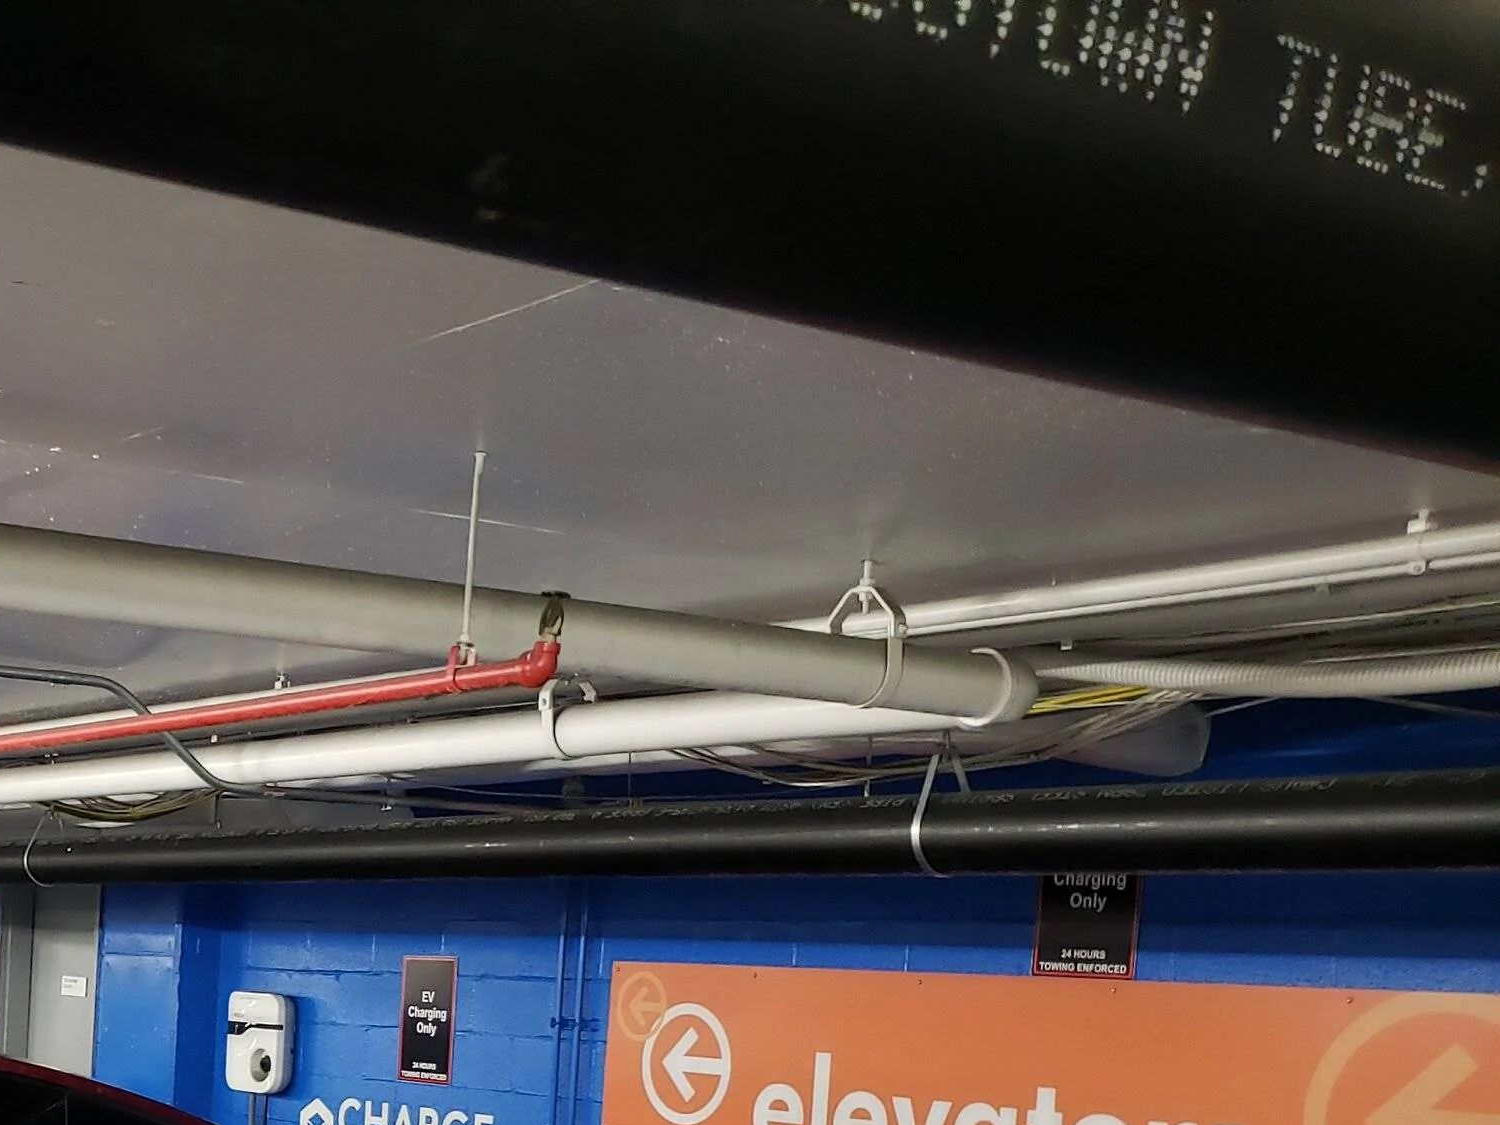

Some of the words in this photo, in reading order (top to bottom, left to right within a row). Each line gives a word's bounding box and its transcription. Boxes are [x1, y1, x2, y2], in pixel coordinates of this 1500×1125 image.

[1069, 892, 1108, 913] Only
[1060, 948, 1072, 959] 24
[1073, 949, 1106, 960] HOURS
[1039, 961, 1075, 972] TOWING
[1076, 963, 1127, 974] ENFORCED
[421, 990, 436, 1003] EV
[407, 1005, 447, 1022] Charging
[416, 1021, 438, 1037] Only
